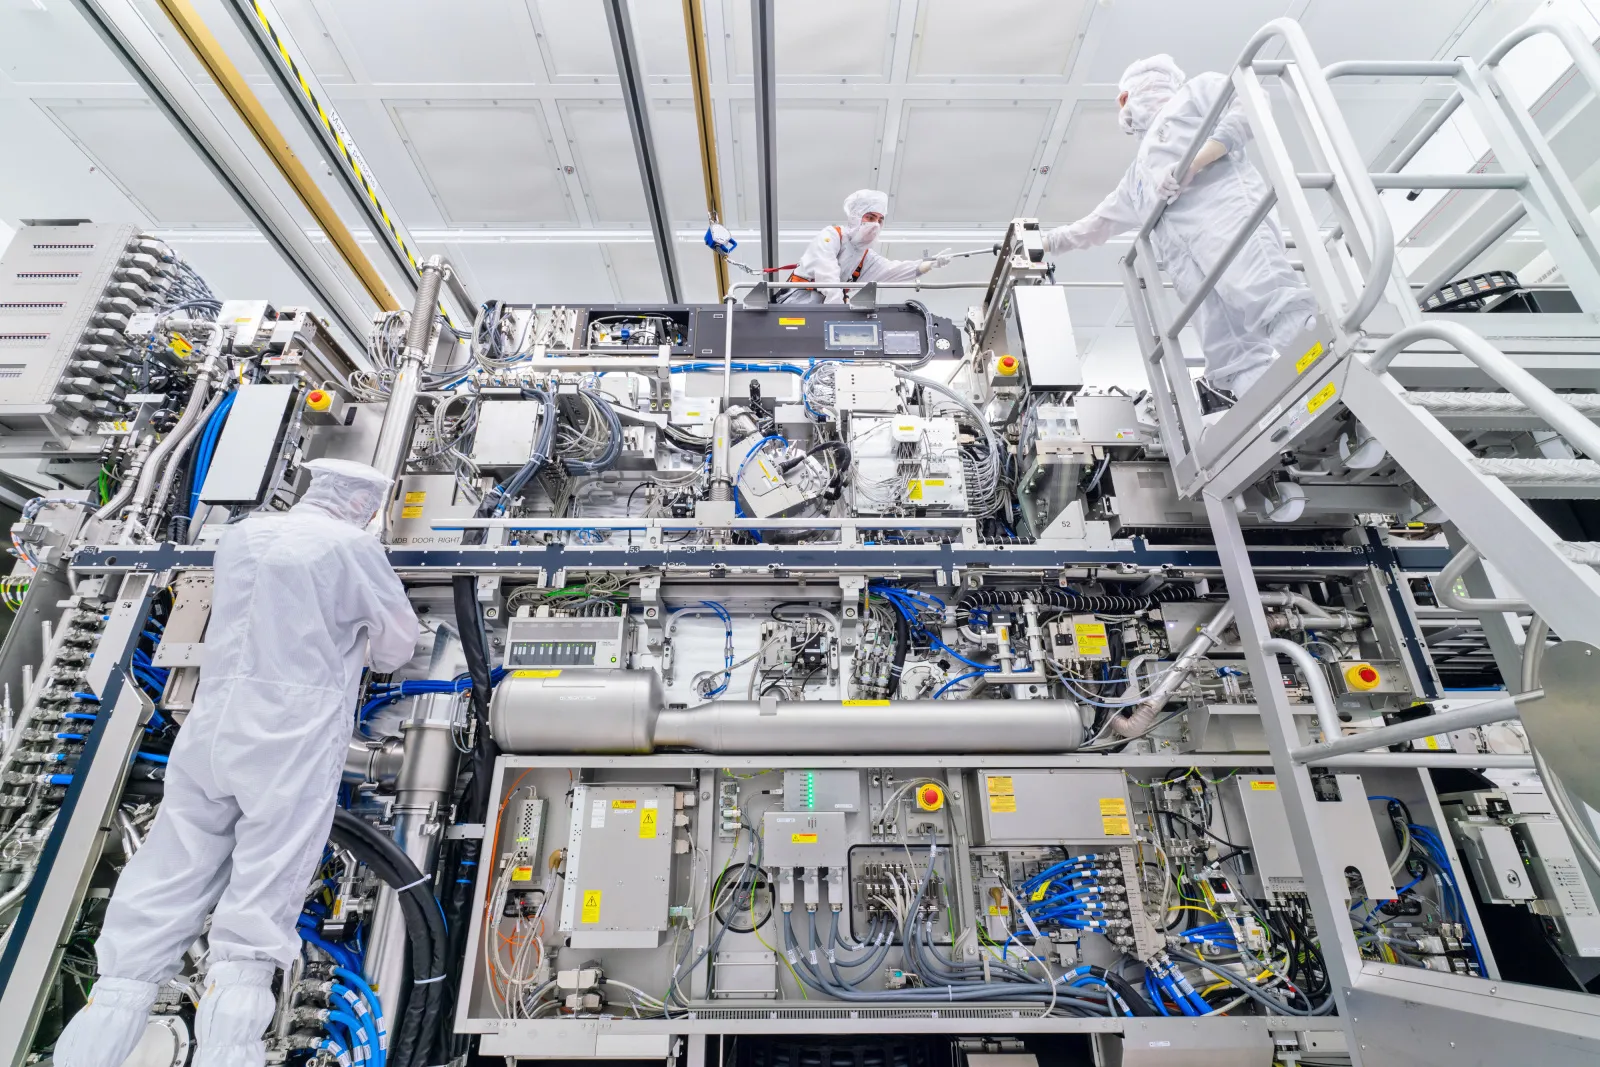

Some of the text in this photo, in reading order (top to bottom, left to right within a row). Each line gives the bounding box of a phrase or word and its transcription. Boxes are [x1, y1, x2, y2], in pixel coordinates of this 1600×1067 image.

[1061, 520, 1071, 528] 52
[438, 536, 461, 544] RIGHT
[629, 545, 640, 554] 53
